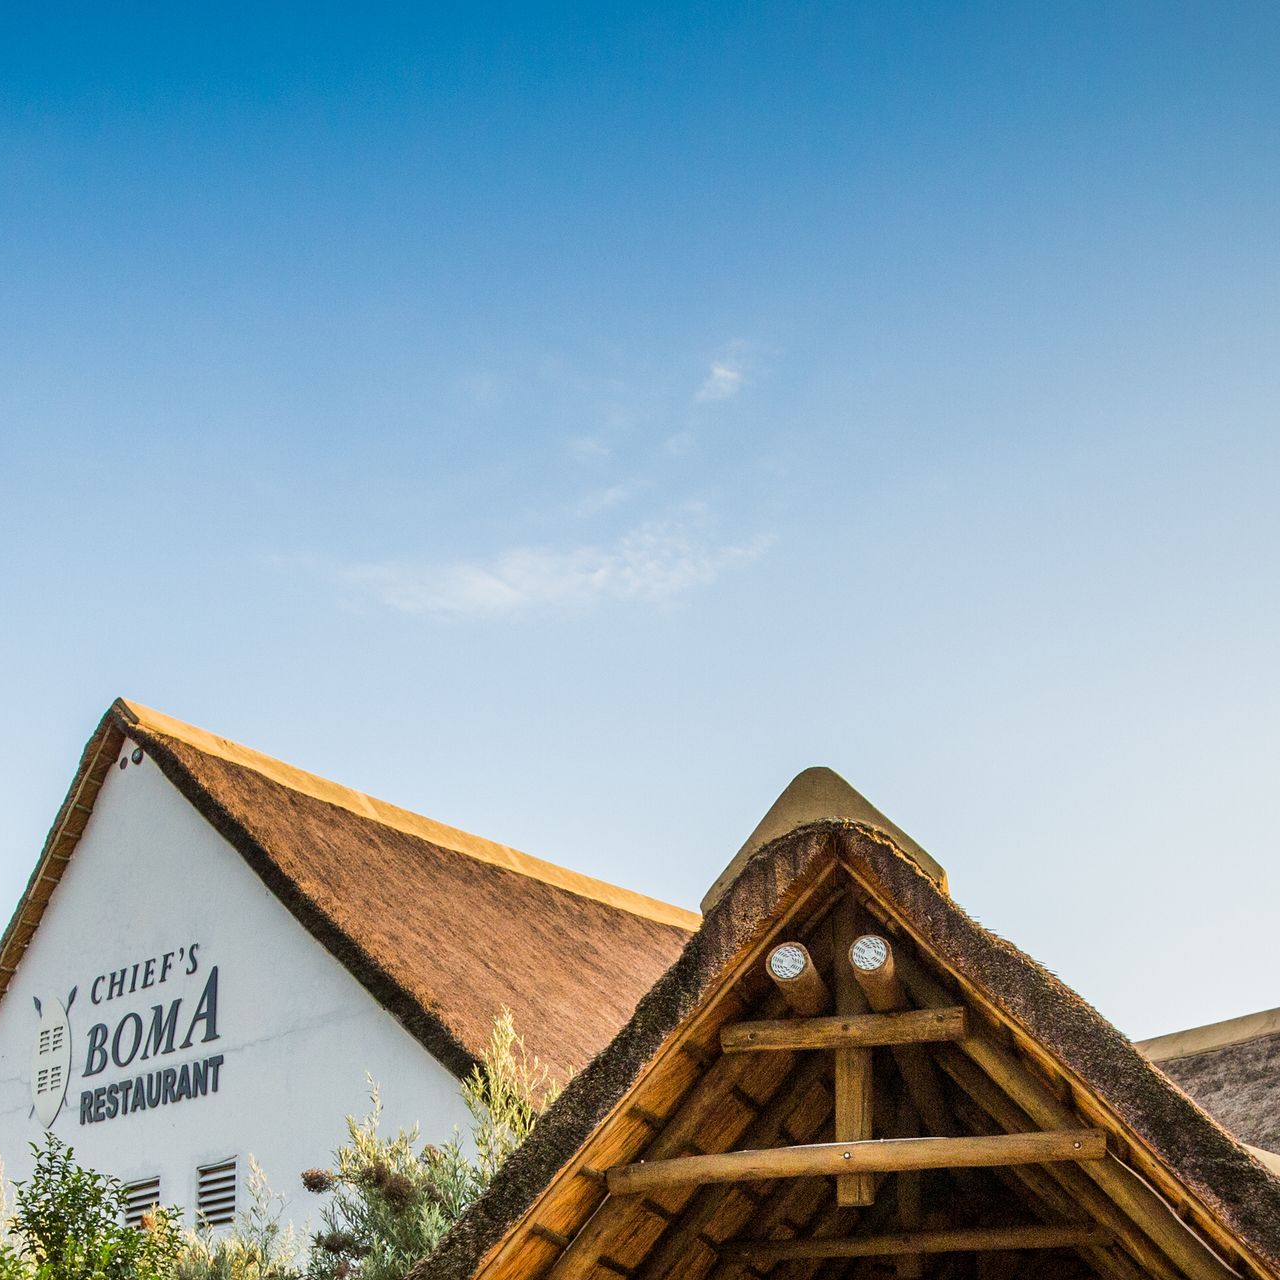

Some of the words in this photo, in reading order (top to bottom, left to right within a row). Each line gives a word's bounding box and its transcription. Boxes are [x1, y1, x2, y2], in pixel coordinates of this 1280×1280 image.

[91, 943, 199, 1005] CHIEF'S
[82, 965, 221, 1078] BOMA
[80, 1054, 224, 1126] RESTAURANT
